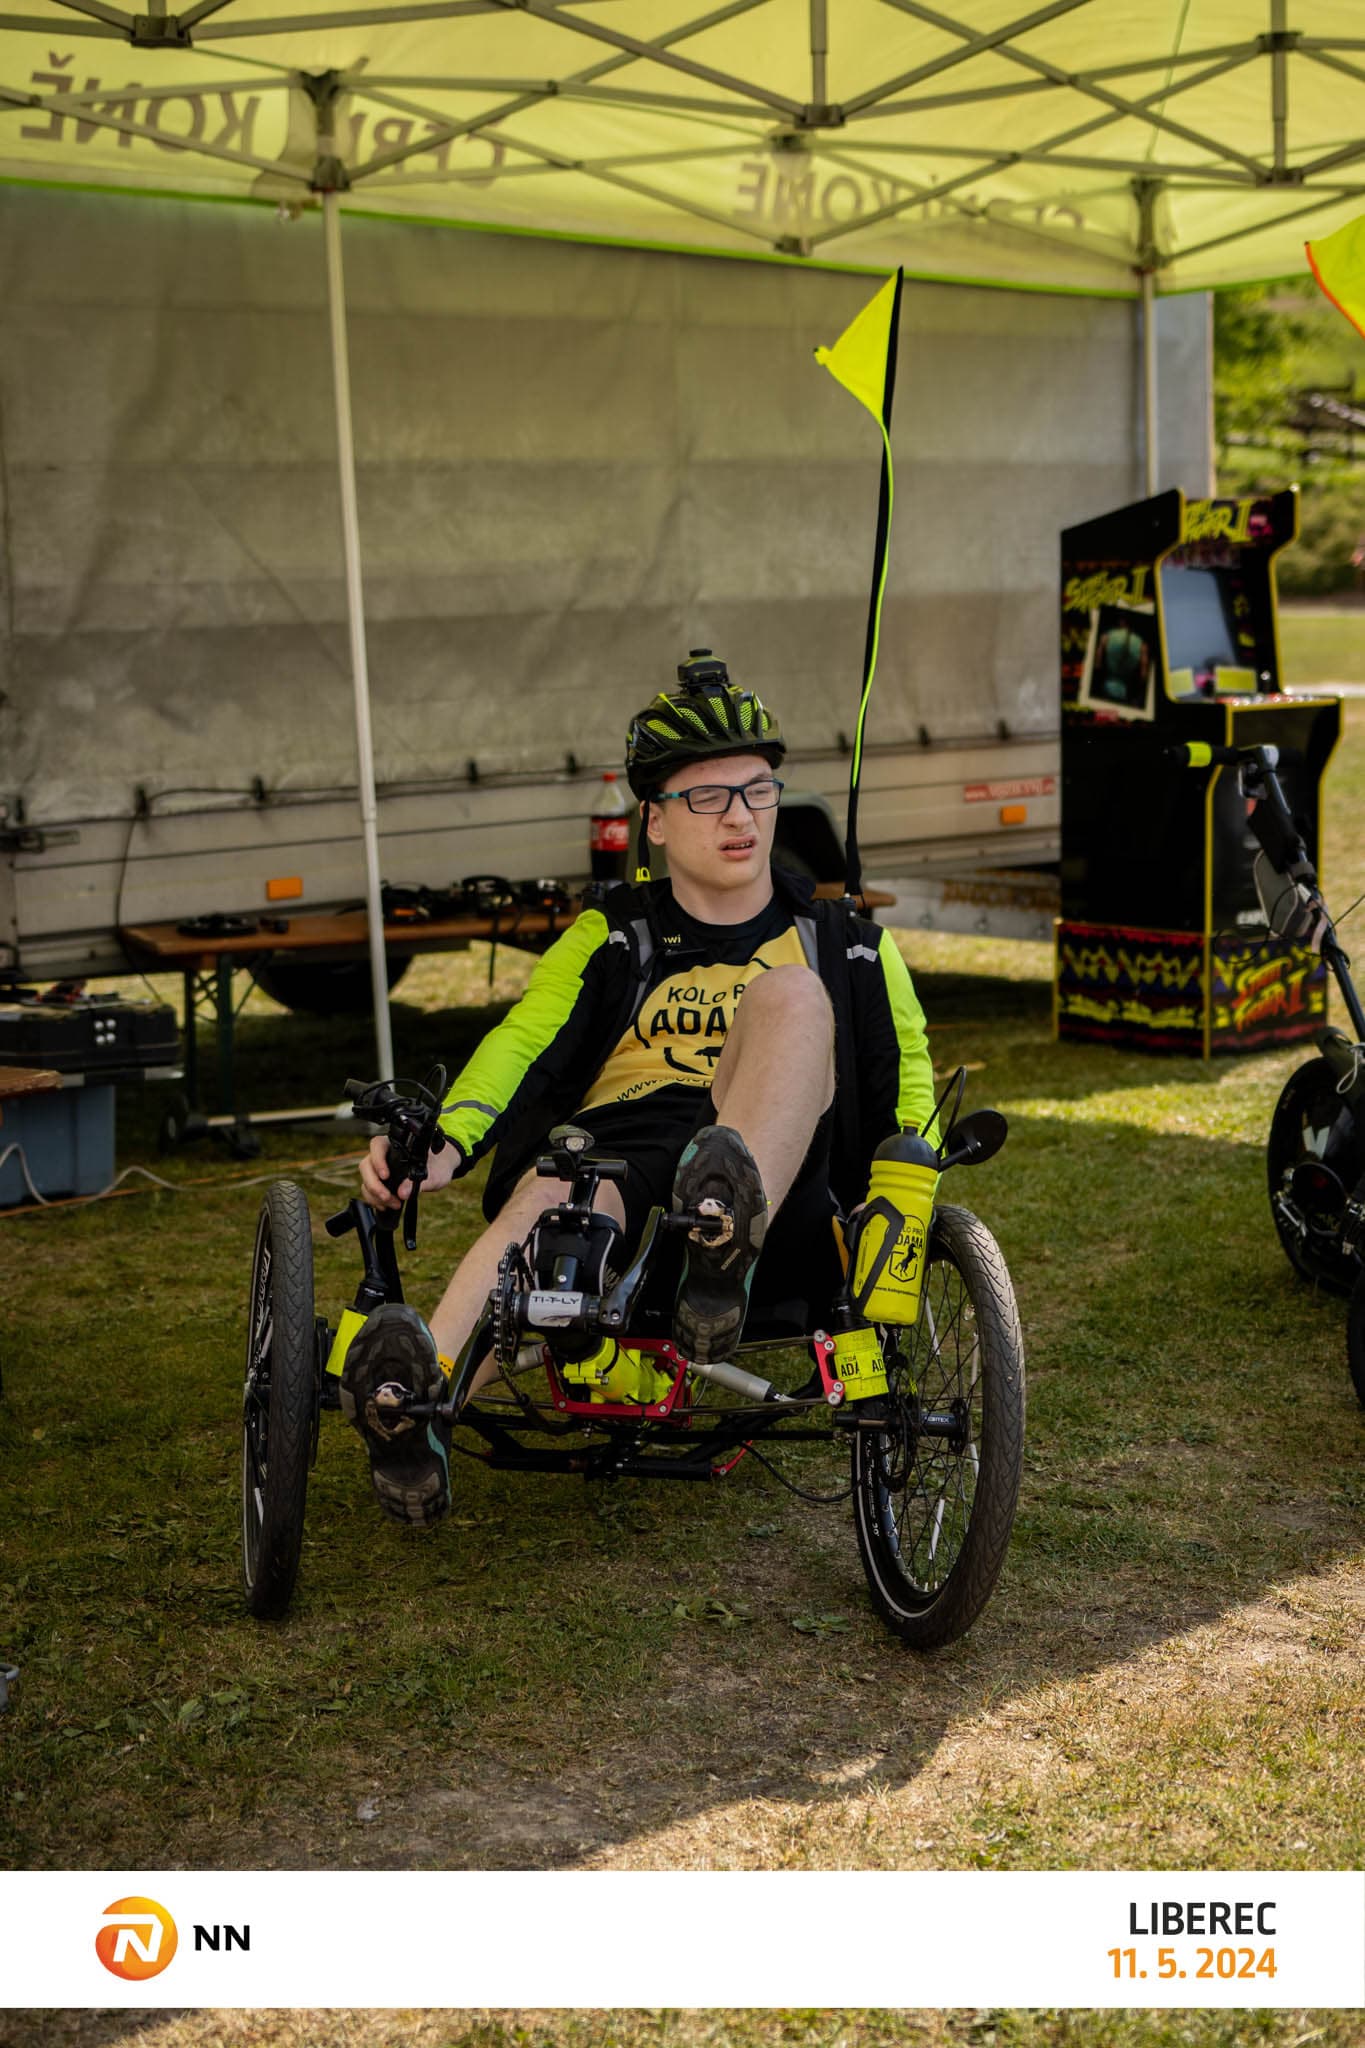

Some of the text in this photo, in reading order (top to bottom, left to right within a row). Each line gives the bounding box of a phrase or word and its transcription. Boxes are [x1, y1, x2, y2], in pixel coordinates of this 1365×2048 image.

[667, 986, 727, 1005] KOLO
[650, 1005, 738, 1037] ADA
[896, 1234, 923, 1249] DAMA
